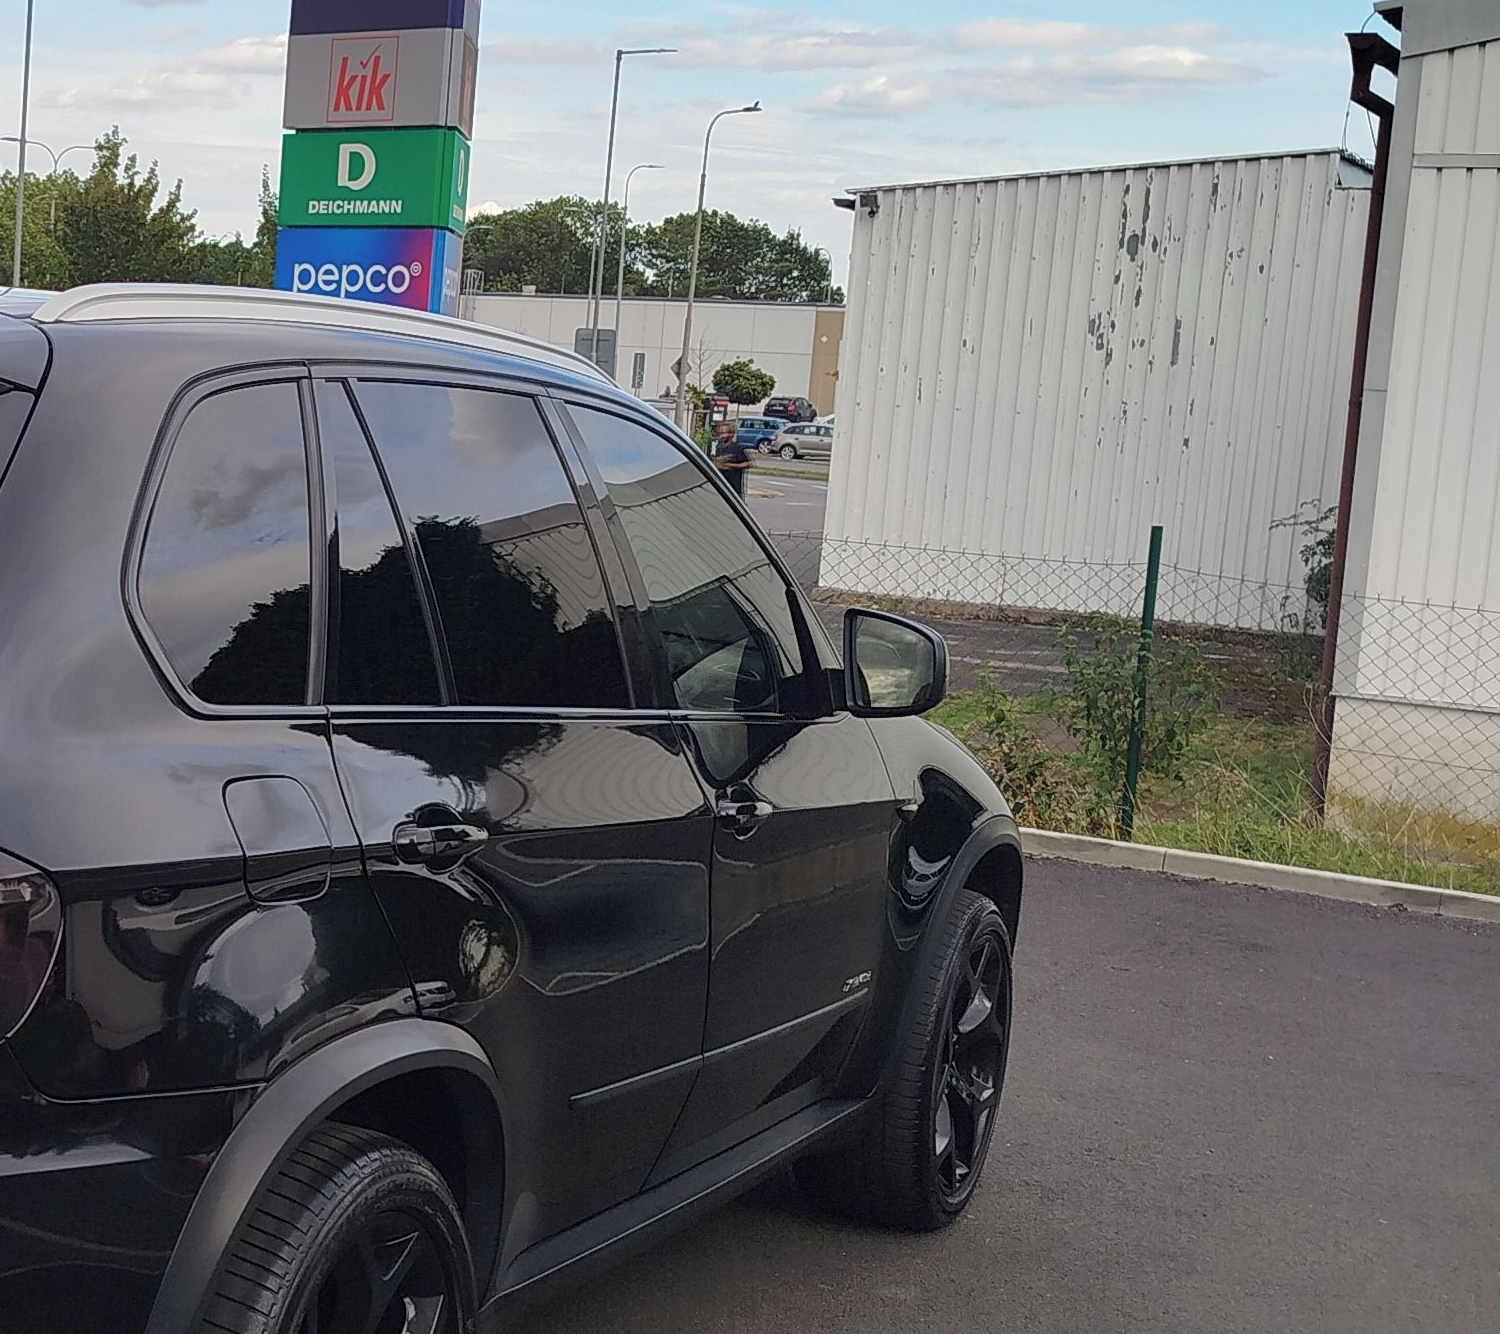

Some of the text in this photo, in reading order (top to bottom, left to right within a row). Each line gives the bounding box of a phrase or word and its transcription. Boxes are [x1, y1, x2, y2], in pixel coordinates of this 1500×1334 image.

[337, 143, 377, 191] D
[307, 199, 403, 215] DEICHMANN
[292, 262, 411, 299] pepco
